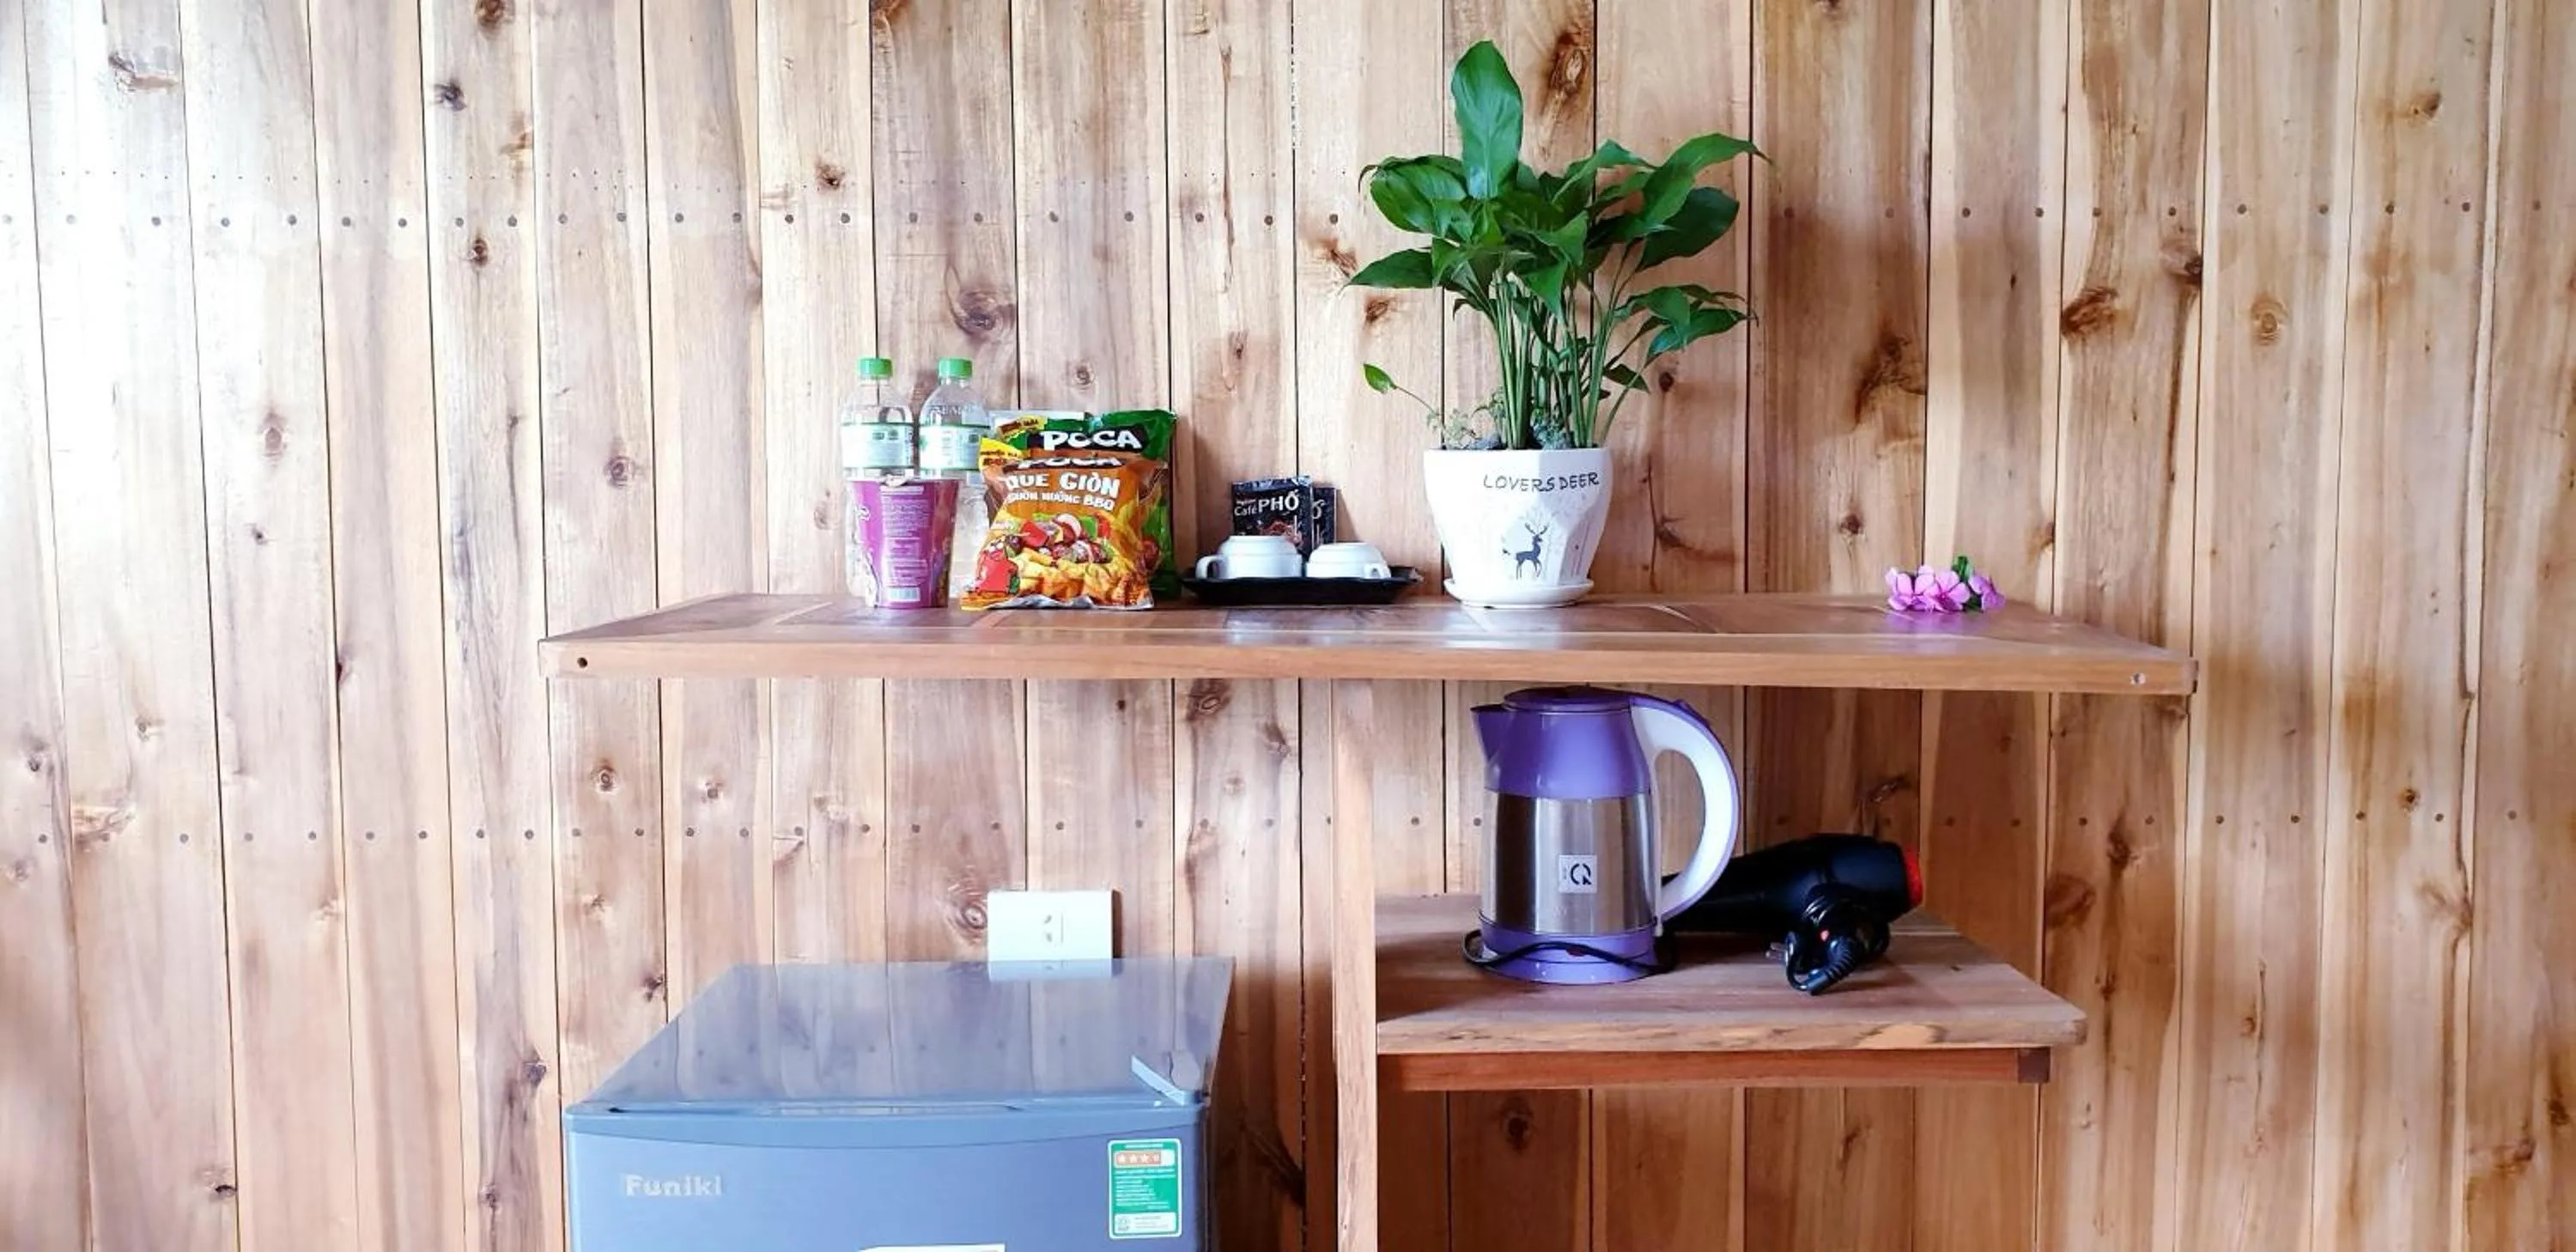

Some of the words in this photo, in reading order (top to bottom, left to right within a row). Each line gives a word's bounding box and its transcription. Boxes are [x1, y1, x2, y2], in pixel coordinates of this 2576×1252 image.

[1040, 430, 1143, 452] POCA
[1483, 474, 1555, 492] LOVERS
[1558, 471, 1600, 490] DEER
